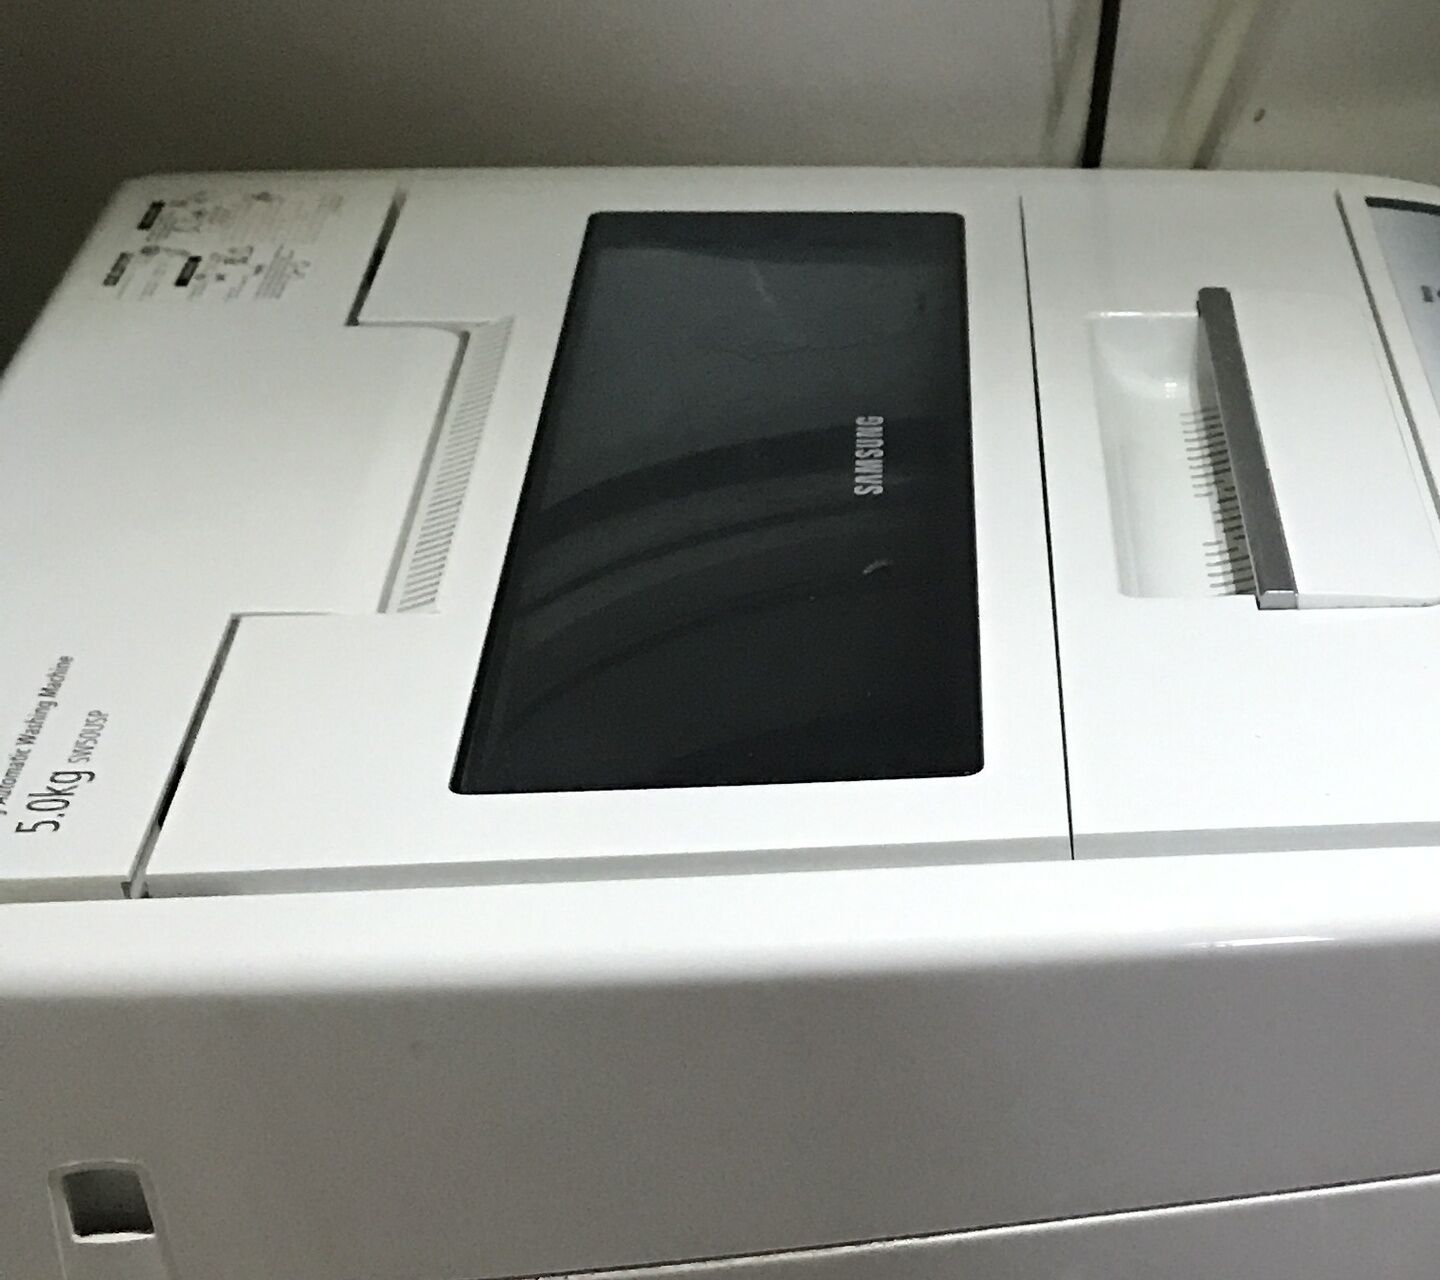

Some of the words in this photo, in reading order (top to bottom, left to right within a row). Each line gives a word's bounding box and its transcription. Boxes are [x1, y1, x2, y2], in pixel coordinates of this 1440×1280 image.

[854, 416, 884, 495] SAMSUNG
[16, 701, 58, 744] Washing
[38, 656, 74, 698] Machine
[15, 770, 95, 834] 5.0kg
